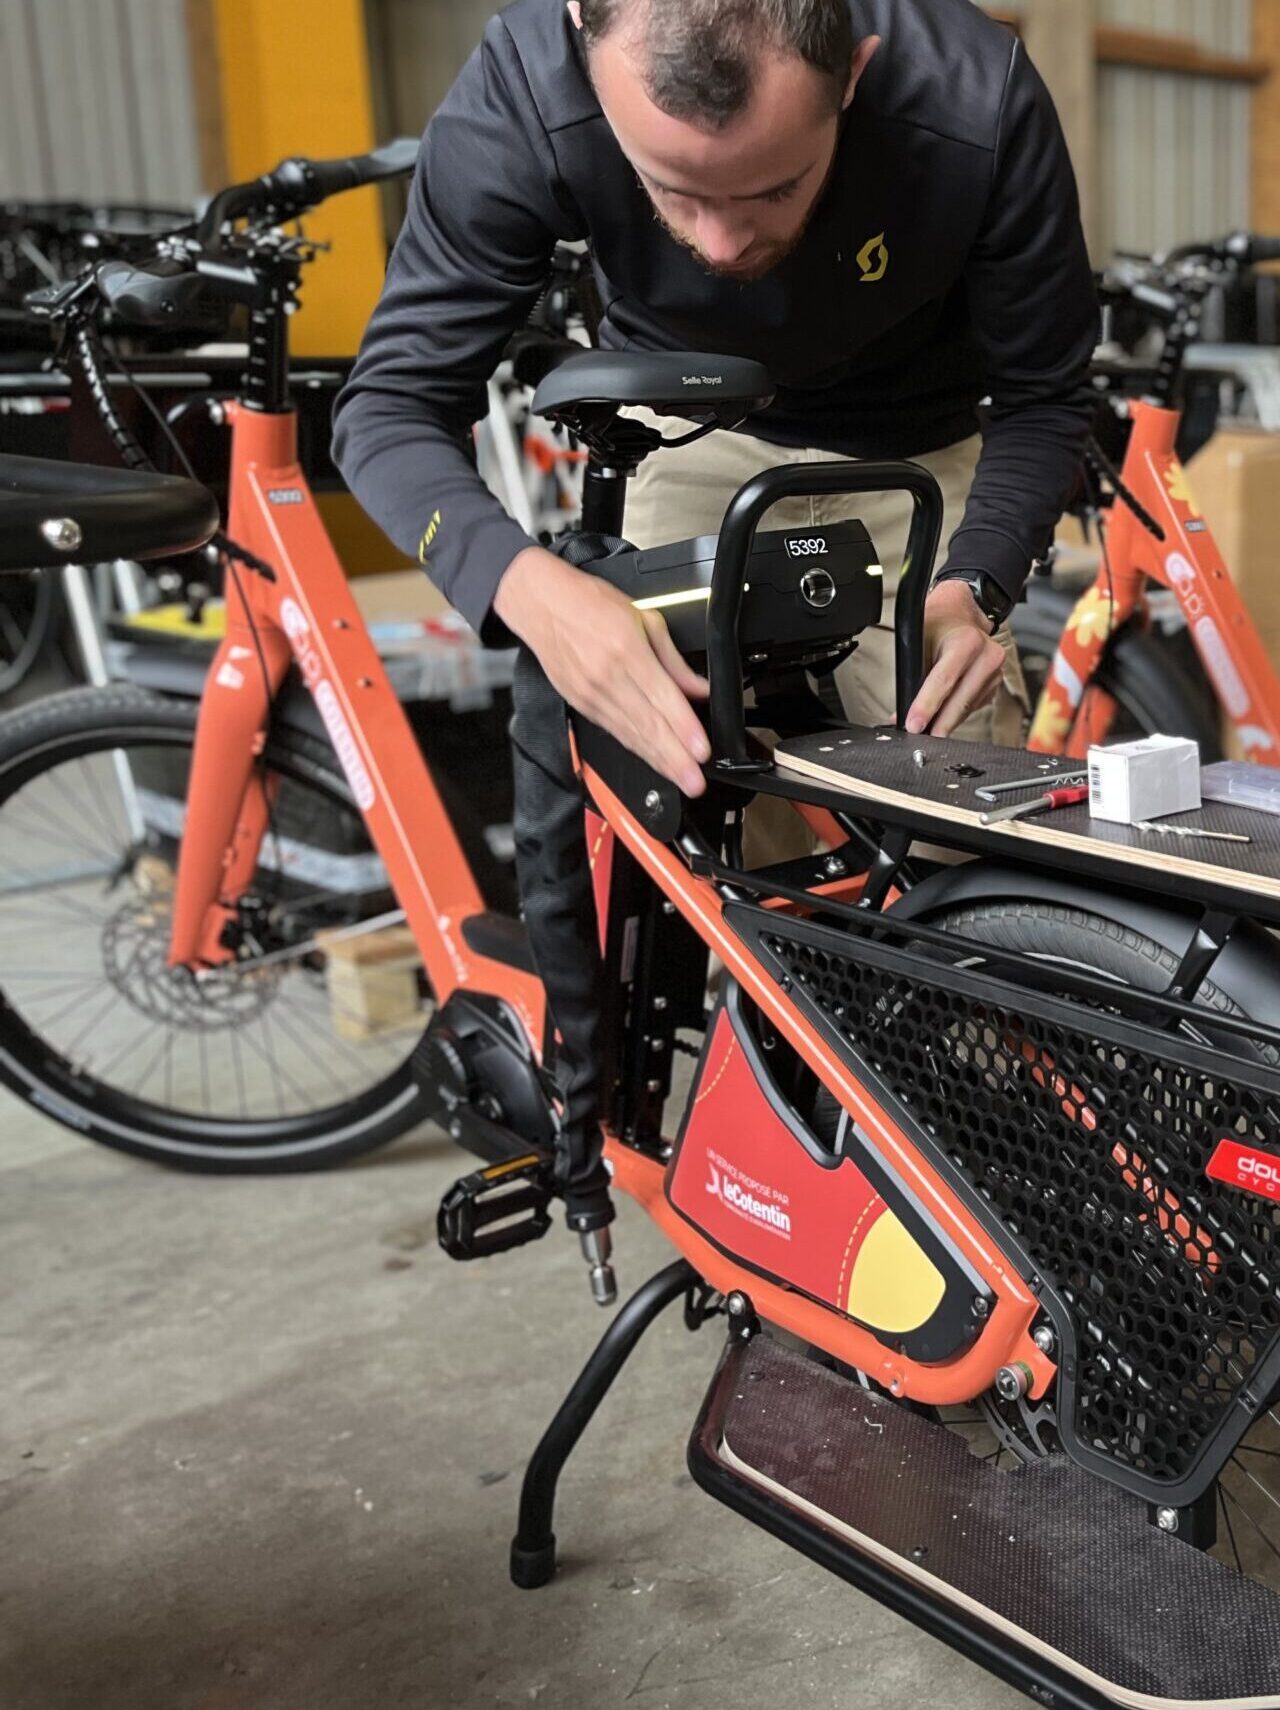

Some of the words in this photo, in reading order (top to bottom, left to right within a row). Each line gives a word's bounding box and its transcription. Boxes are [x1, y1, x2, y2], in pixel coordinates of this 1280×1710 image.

[682, 376, 701, 385] Selle
[701, 375, 723, 386] Royal
[789, 538, 829, 556] 5392
[723, 1174, 791, 1233] leCotentin
